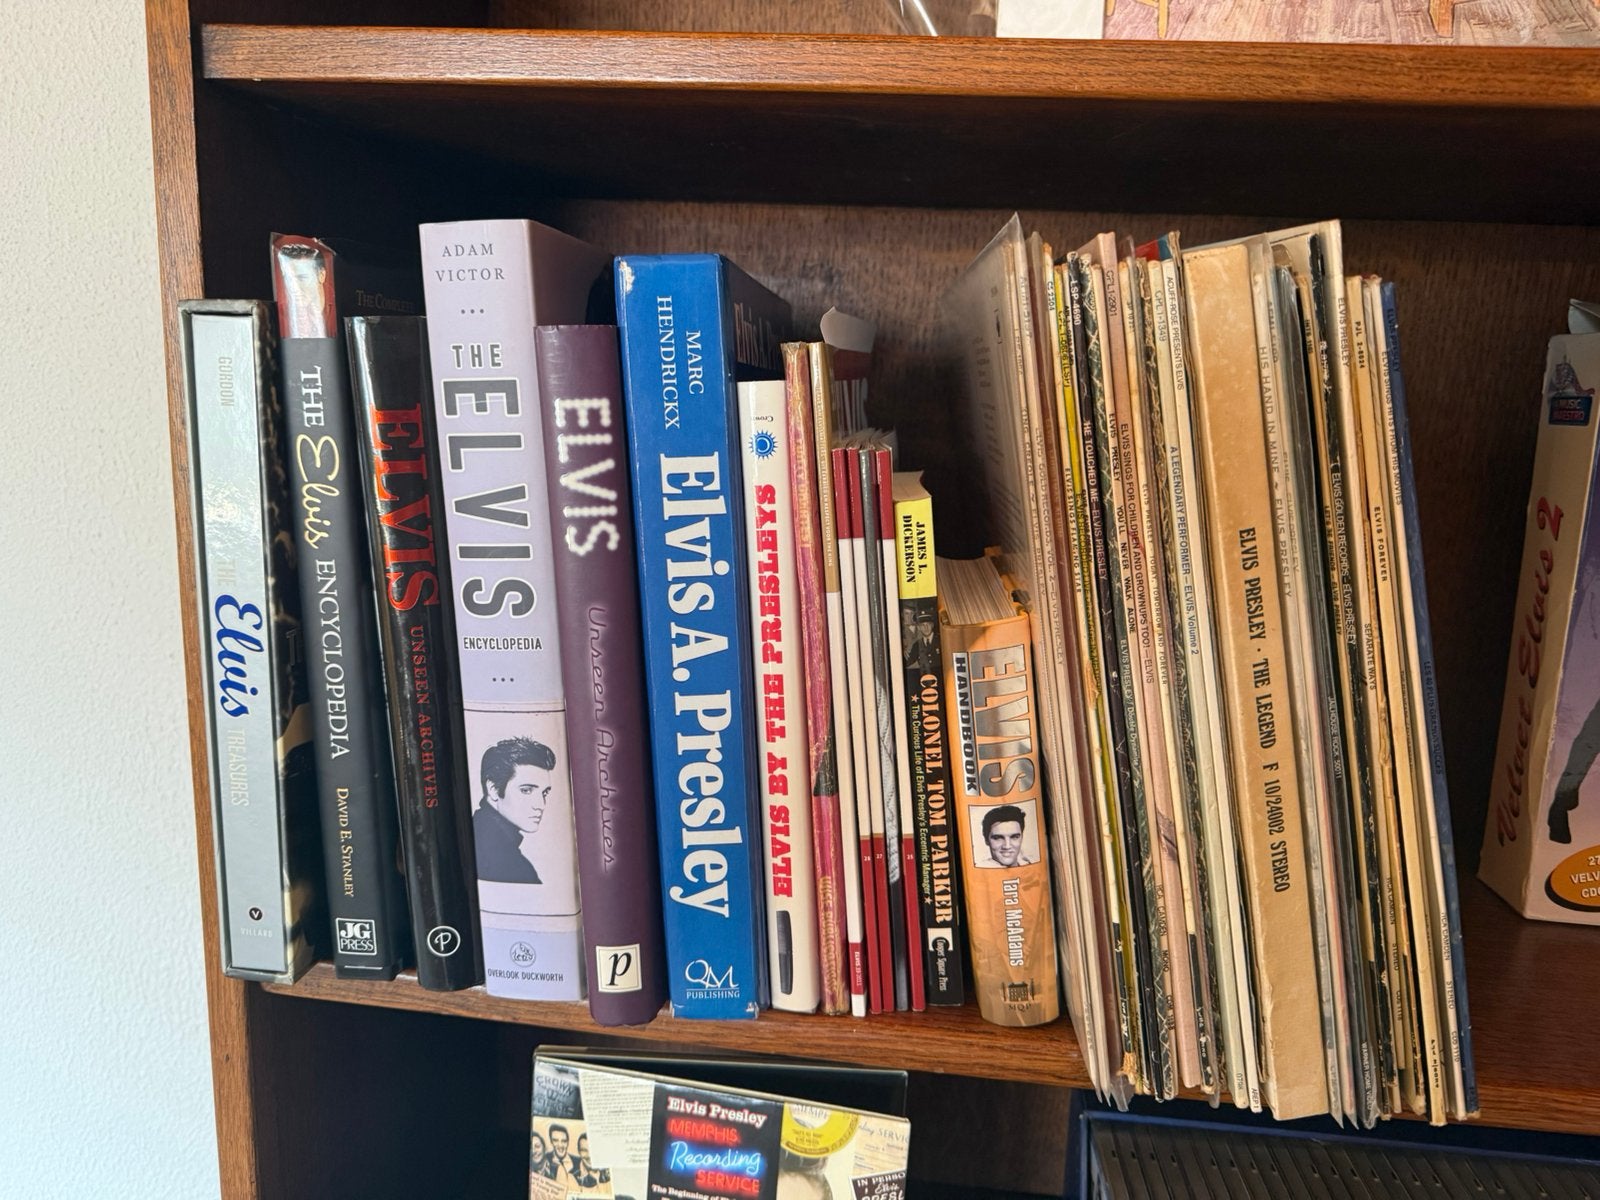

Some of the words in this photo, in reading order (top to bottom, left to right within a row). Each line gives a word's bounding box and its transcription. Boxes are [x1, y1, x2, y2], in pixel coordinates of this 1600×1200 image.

[442, 243, 494, 257] ADAM
[436, 268, 505, 282] VICTOR
[1069, 280, 1082, 326] LSP-4690
[1165, 276, 1178, 326] ACUFF-ROSE
[1336, 296, 1346, 324] ELVIS
[1354, 320, 1362, 336] PJL
[451, 343, 503, 369] THE
[657, 295, 680, 430] HENDRICKX
[686, 330, 704, 395] MARC
[1171, 326, 1183, 368] PRESENTS
[1258, 346, 1269, 369] HIS
[1339, 326, 1350, 368] PRESLEY
[218, 356, 235, 406] GORDON
[300, 365, 323, 427] THE
[1175, 370, 1184, 390] ELVIS
[1261, 375, 1274, 414] HAND
[1082, 420, 1091, 436] HE
[1108, 412, 1117, 438] ELVIS
[1119, 424, 1131, 450] ELVIS
[1266, 420, 1276, 434] IN
[1084, 439, 1097, 485] TOUCHED
[1110, 446, 1121, 482] PRESLEY
[1122, 452, 1133, 480] SINGS
[1268, 440, 1281, 472] MINE
[297, 433, 340, 549] Elvis
[554, 397, 620, 556] ELVIS
[1064, 468, 1073, 492] ELVIS
[1125, 482, 1136, 501] FOR
[1170, 454, 1184, 514] LEGENDARY
[1331, 472, 1342, 498] ELVIS
[370, 403, 439, 611] ELVIS
[441, 377, 538, 618] ELVIS
[1067, 494, 1076, 524] SINGS
[660, 451, 730, 615] Elvis
[1127, 503, 1141, 548] CHILDREN
[1274, 498, 1286, 534] ELVIS
[1334, 498, 1346, 534] GOLDEN
[1374, 506, 1383, 533] ELVIS
[1536, 496, 1564, 541] 2
[902, 515, 915, 583] DICKERSON
[916, 522, 927, 560] JAMES
[1119, 542, 1129, 570] NEVER
[1176, 516, 1191, 575] PERFORMER
[1239, 527, 1259, 571] ELVIS
[1337, 534, 1350, 576] RECORDS
[755, 484, 783, 664] PRESLEYS
[917, 564, 927, 574] L.
[1095, 538, 1107, 580] PRESLEY
[1132, 551, 1142, 570] AND
[1377, 538, 1387, 582] FOREVER
[1123, 576, 1132, 600] WALK
[1134, 574, 1148, 624] GROWNUPS
[1342, 582, 1353, 606] ELVIS
[1126, 606, 1136, 634] ALONE
[1244, 577, 1266, 641] PRESLEY
[463, 636, 542, 650] ENCYCLOPEDIA
[1140, 626, 1151, 648] TOO!
[1187, 614, 1198, 648] Volume
[1362, 622, 1375, 665] SEPARATE
[215, 594, 265, 718] Elvis
[314, 559, 350, 759] ENCYCLOPEDIA
[409, 625, 430, 705] UNSEEN
[588, 607, 609, 721] Unseen
[670, 622, 729, 682] A.
[1119, 638, 1129, 662] ELVIS
[1191, 648, 1199, 656] 2
[1144, 658, 1154, 684] ELVIS
[1252, 658, 1271, 688] THE
[1367, 666, 1377, 690] WAYS
[763, 674, 786, 743] THE
[911, 705, 920, 719] The
[920, 674, 943, 774] COLONEL
[955, 657, 978, 791] HANDBOOK
[970, 644, 1036, 797] ELVIS
[1255, 693, 1277, 749] LEGEND
[912, 721, 922, 749] Curious
[227, 729, 249, 806] TREASURES
[418, 714, 439, 808] ARCHIVES
[766, 752, 789, 796] BY
[914, 751, 923, 764] Life
[1263, 761, 1279, 771] F
[595, 728, 618, 873] Archives
[916, 775, 925, 792] Elvis
[335, 788, 351, 826] DAVID
[669, 690, 742, 918] Presley
[916, 794, 927, 826] Presley's
[928, 780, 947, 826] TOM
[1264, 779, 1285, 835] 10/24002
[339, 830, 352, 842] E.
[769, 805, 793, 898] ELVIS
[920, 828, 930, 861] Eccentric
[341, 845, 355, 897] STANLEY
[921, 862, 932, 894] Manager
[931, 835, 953, 923] PARKER
[1269, 840, 1291, 892] STEREO
[1003, 878, 1021, 904] Tara
[340, 923, 371, 941] JG
[1005, 909, 1026, 966] McAdams
[1157, 906, 1167, 936] CAMDEN
[341, 940, 373, 954] PRESS
[1160, 948, 1170, 972] MONO
[488, 969, 520, 981] OVERLOOK
[522, 971, 564, 982] DUCKWORTH
[687, 990, 740, 999] PUBLISHING
[1359, 1042, 1369, 1069] WARNER
[1363, 1070, 1371, 1088] HOME
[668, 1096, 707, 1117] Elvis
[708, 1103, 767, 1129] Presley
[668, 1118, 739, 1143] MEMPHIS
[669, 1141, 762, 1176] Recording
[652, 1184, 667, 1194] The
[696, 1171, 760, 1193] SERVICE
[857, 1179, 868, 1187] IN
